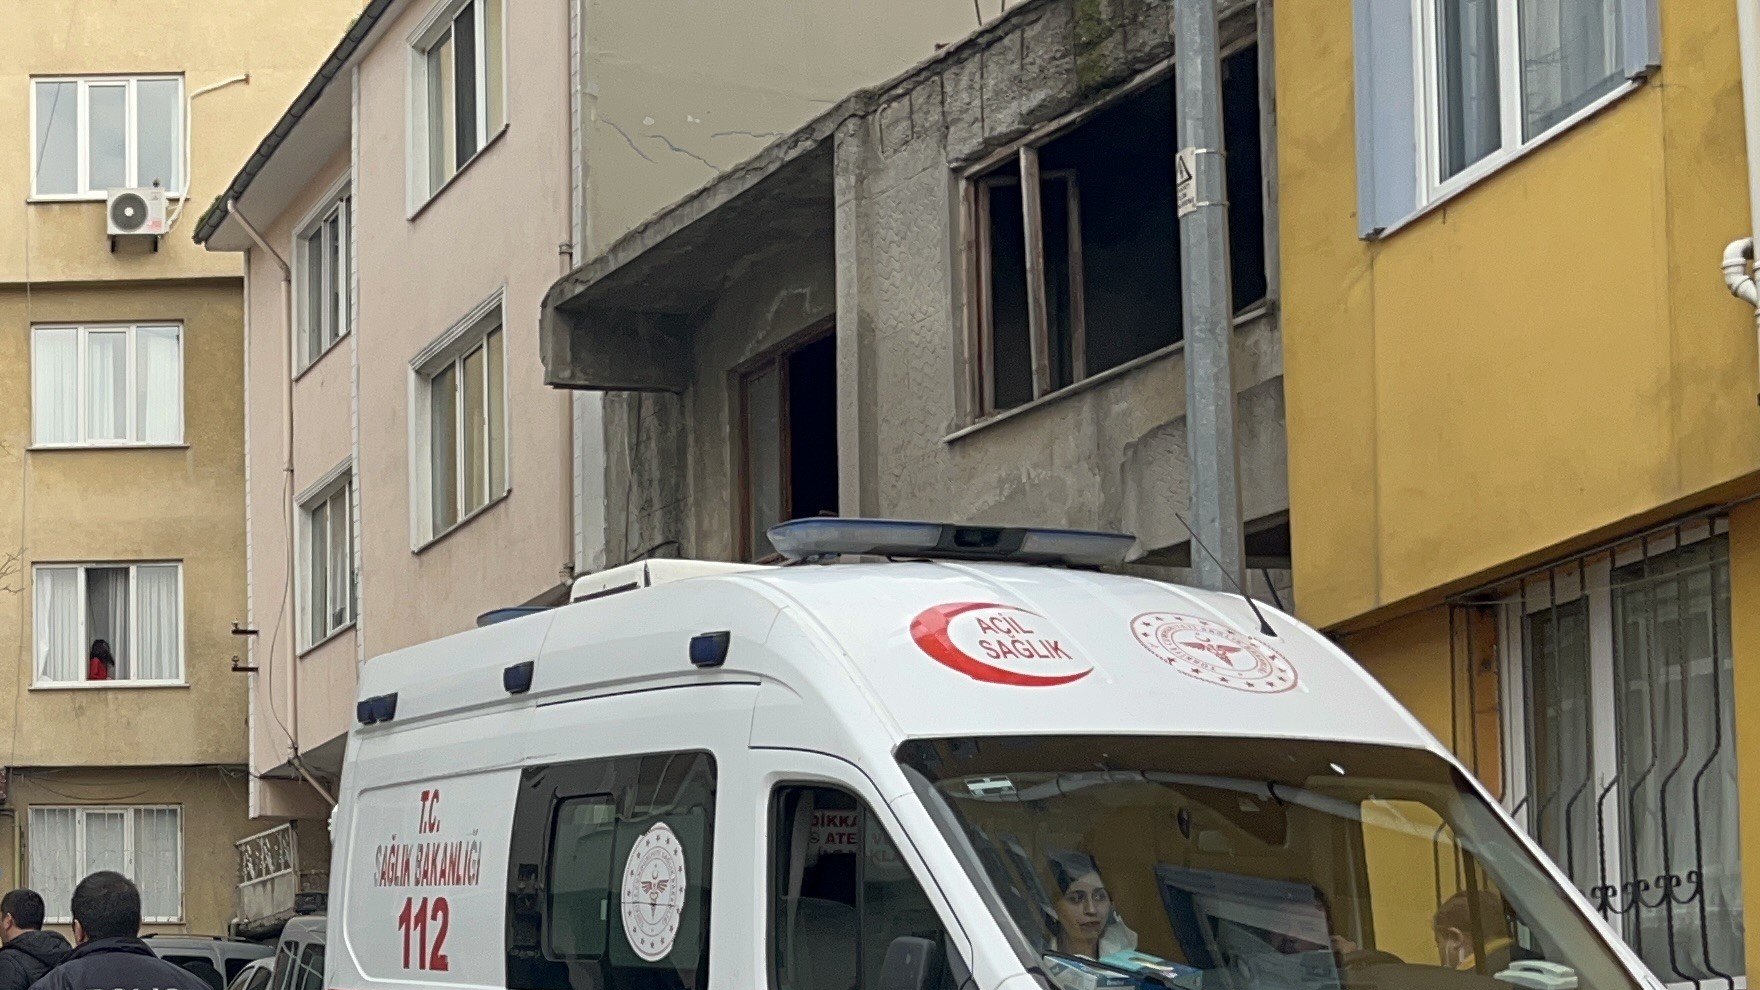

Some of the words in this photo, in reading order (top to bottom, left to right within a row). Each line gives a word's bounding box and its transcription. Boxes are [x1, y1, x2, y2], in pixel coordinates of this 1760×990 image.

[979, 636, 1073, 660] SAĞLIK
[419, 789, 440, 834] T.C.
[374, 834, 413, 887] SAĞLIK
[414, 829, 482, 887] BAKANLIĞI
[398, 896, 449, 972] 112
